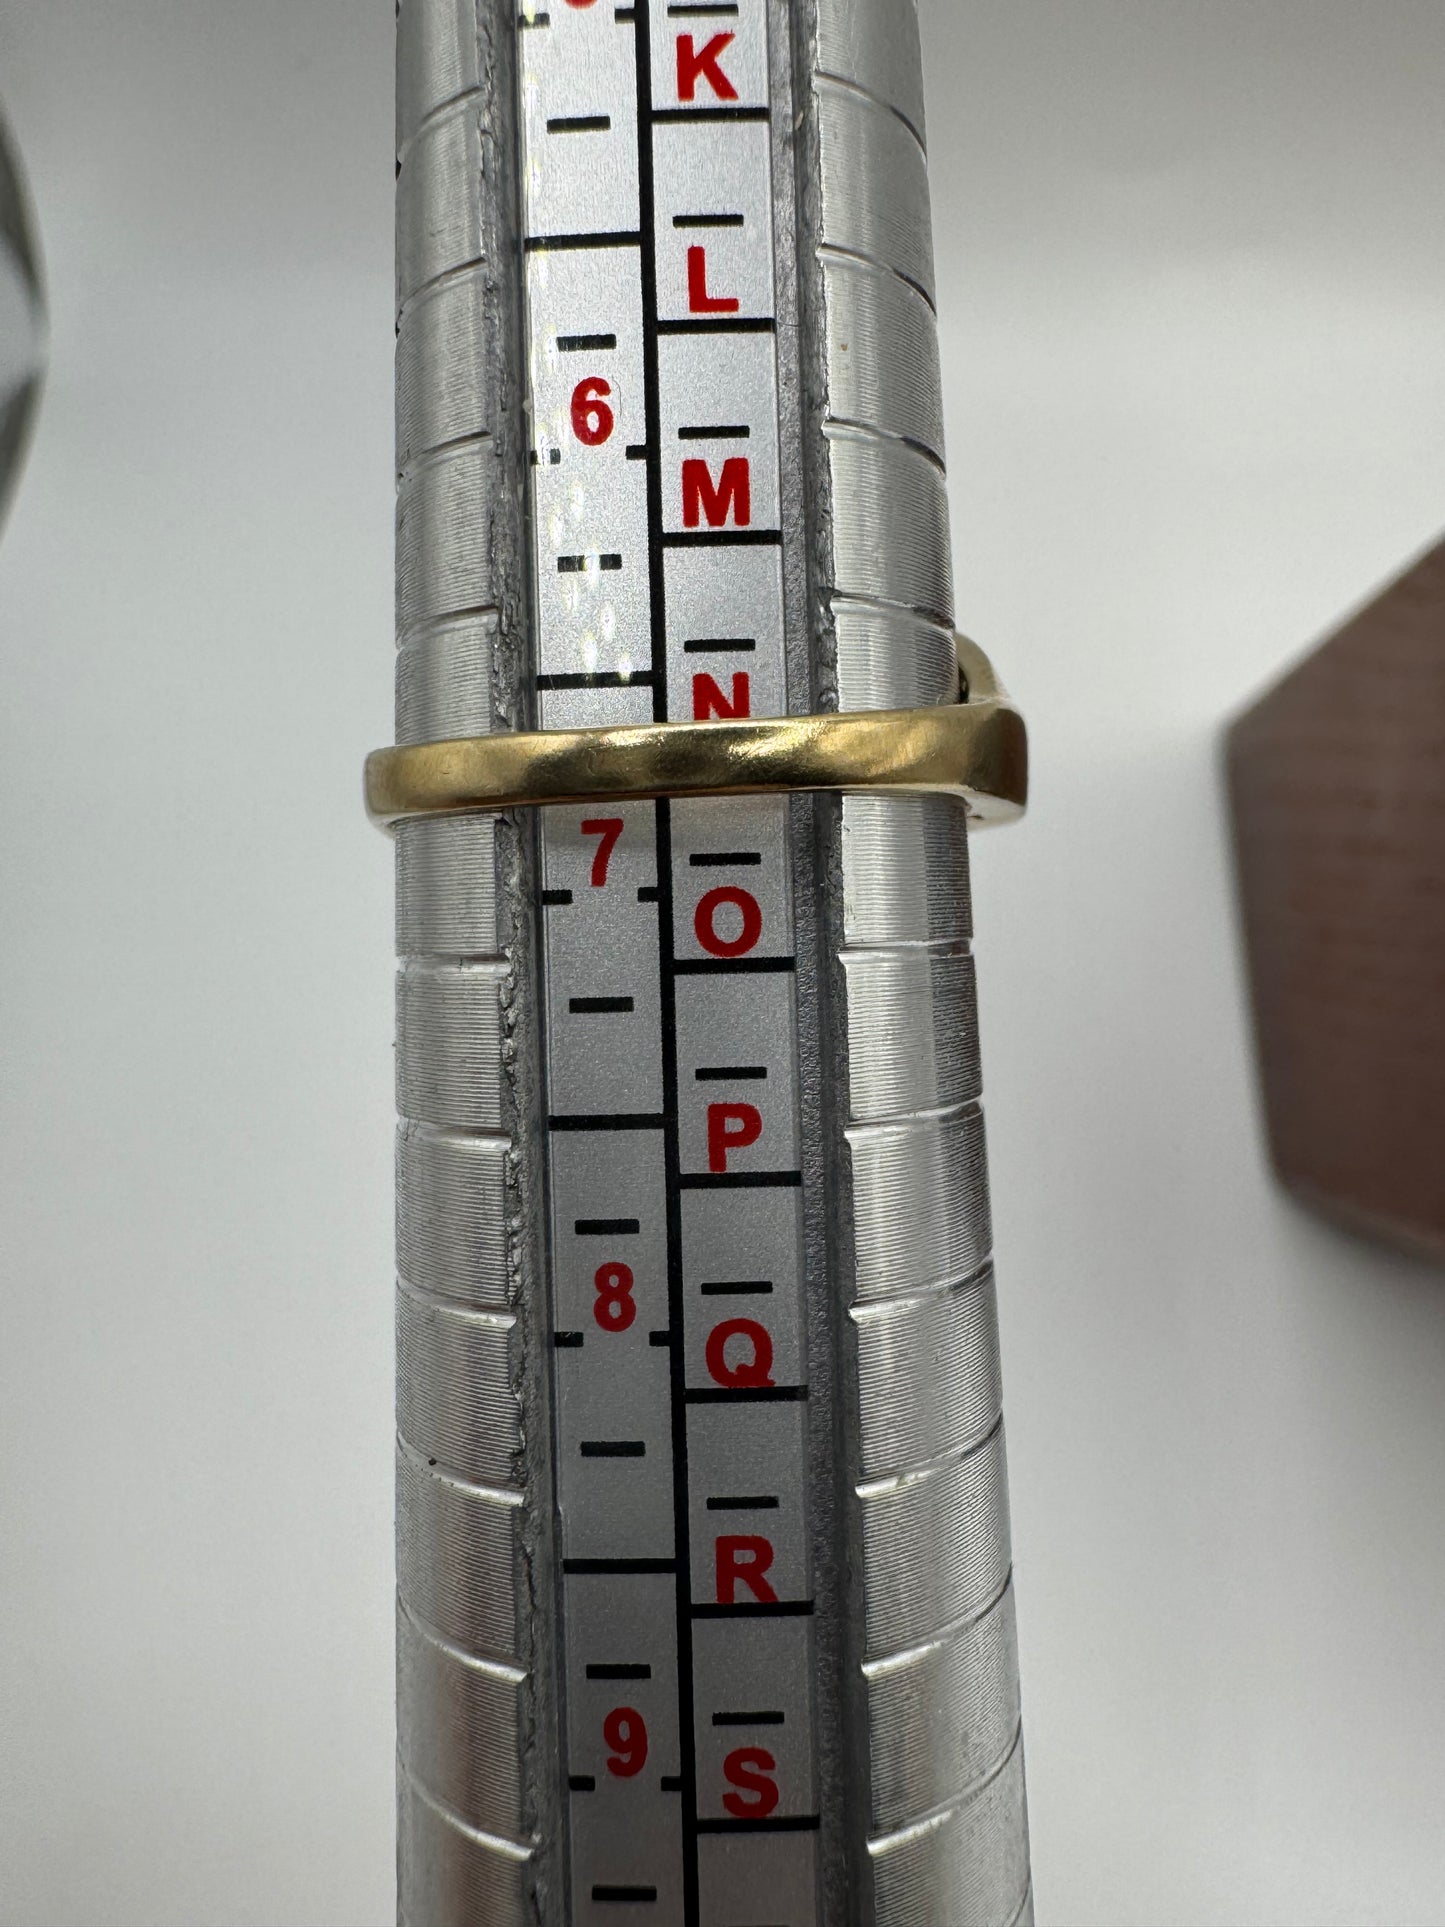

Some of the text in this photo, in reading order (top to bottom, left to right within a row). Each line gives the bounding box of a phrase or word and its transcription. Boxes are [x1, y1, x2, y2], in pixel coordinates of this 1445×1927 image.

[676, 33, 738, 101] K
[688, 246, 740, 314] L
[571, 377, 614, 446] 6
[682, 458, 750, 528] M
[692, 671, 750, 721] N
[580, 818, 624, 887] 7
[695, 886, 762, 959] O
[708, 1103, 763, 1174] P
[594, 1264, 634, 1331] 8
[706, 1320, 774, 1388] Q
[716, 1537, 776, 1605] R
[604, 1707, 648, 1777] 9
[722, 1747, 779, 1818] S
